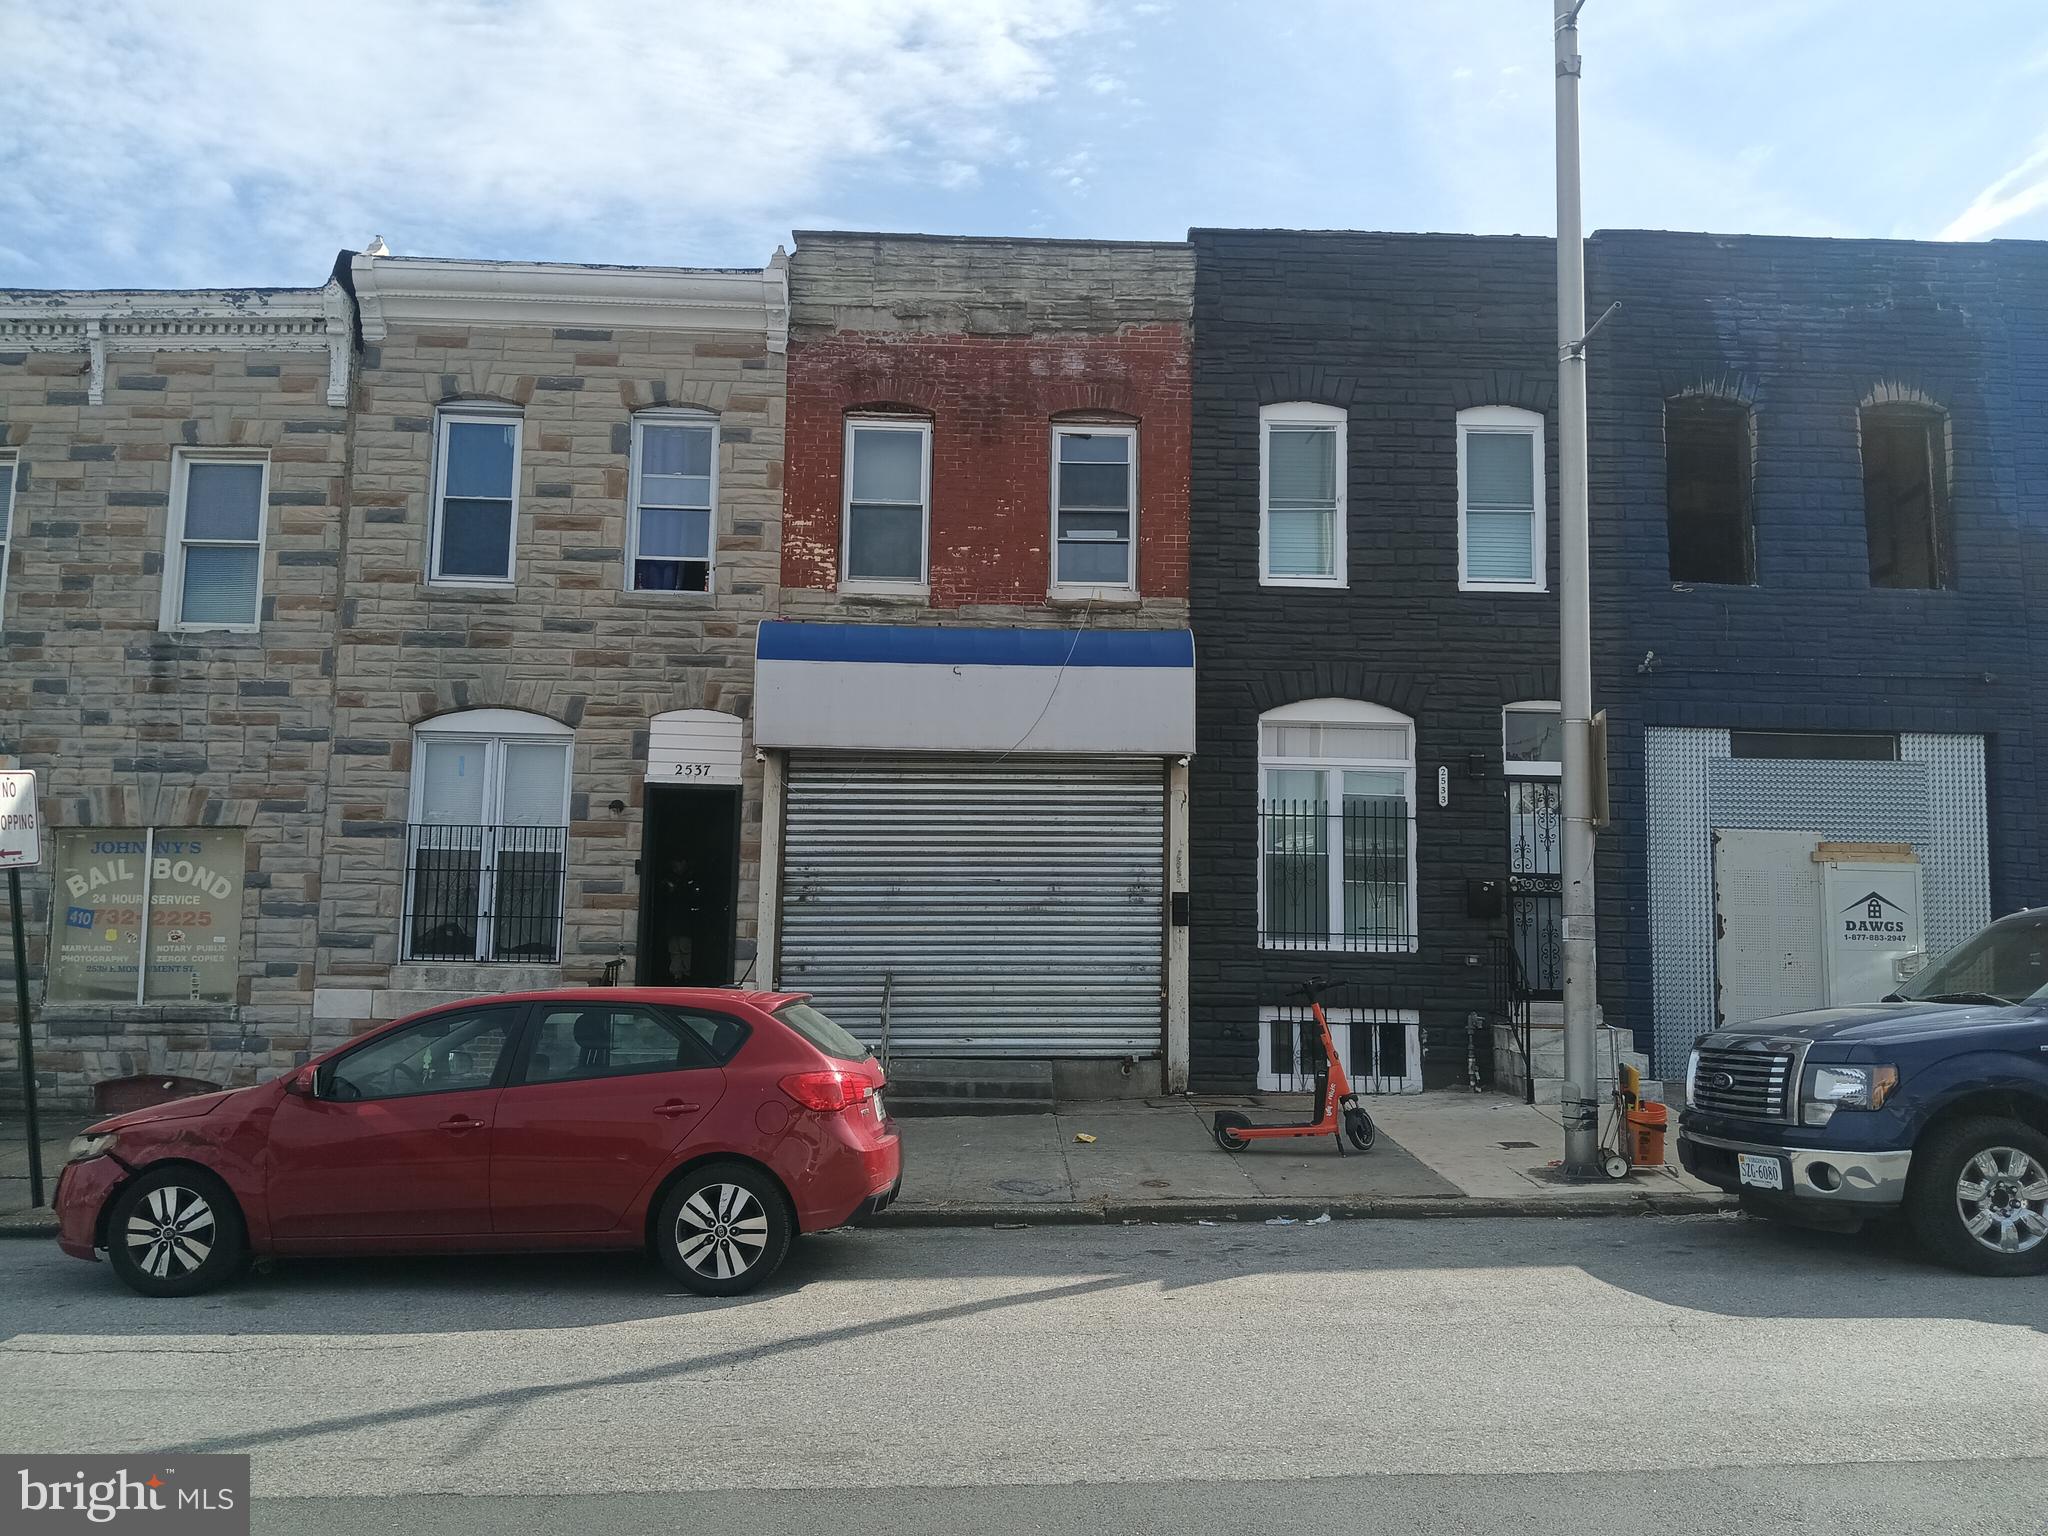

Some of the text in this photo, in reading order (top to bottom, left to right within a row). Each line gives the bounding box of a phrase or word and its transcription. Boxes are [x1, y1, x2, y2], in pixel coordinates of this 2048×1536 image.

[674, 763, 711, 777] 2537
[2, 781, 17, 798] NO
[90, 841, 202, 855] JOHNNY'S
[65, 857, 233, 900] BAIL BOND
[92, 894, 201, 905] 24 HOUR SERVICE
[69, 911, 92, 926] 410
[1843, 933, 1907, 942] 1-877-883-2947
[61, 944, 113, 953] MARYLAND
[156, 944, 228, 953] NOTARY PUBLIC
[60, 954, 129, 963] PHOTOGRAPHY
[155, 954, 225, 963] ZEROX COPIES
